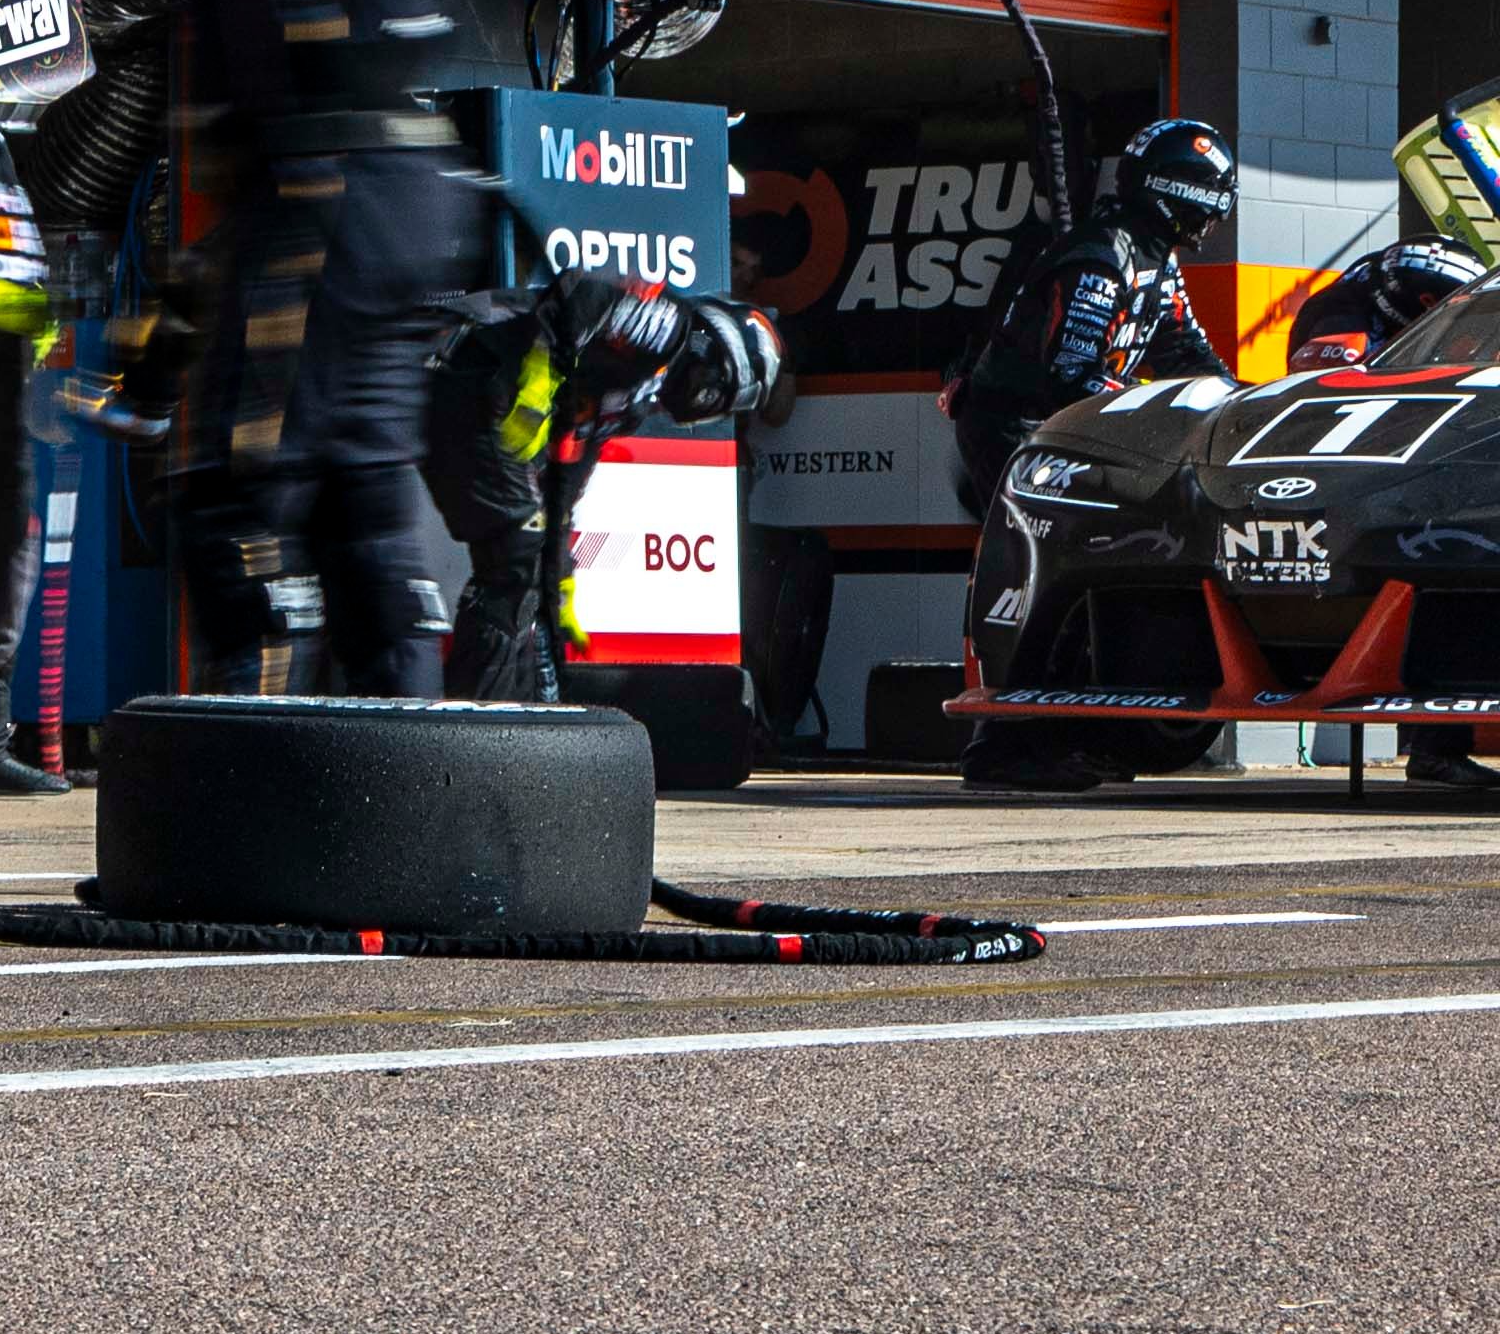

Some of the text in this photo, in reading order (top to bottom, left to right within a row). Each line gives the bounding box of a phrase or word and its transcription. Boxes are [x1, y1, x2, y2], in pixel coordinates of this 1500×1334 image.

[540, 124, 645, 187] Mobil
[864, 160, 1052, 235] TRU
[1144, 173, 1219, 207] HEATWAVE
[546, 227, 697, 289] OPTUS
[836, 237, 1012, 312] ASS
[1074, 287, 1114, 308] Coates
[1079, 272, 1119, 297] NTK
[1061, 332, 1098, 354] Lloyds
[767, 450, 894, 477] WESTERN
[1017, 451, 1092, 489] NGK
[645, 533, 716, 573] BOC
[1222, 519, 1330, 560] NTK
[997, 688, 1186, 709] JB Caravans
